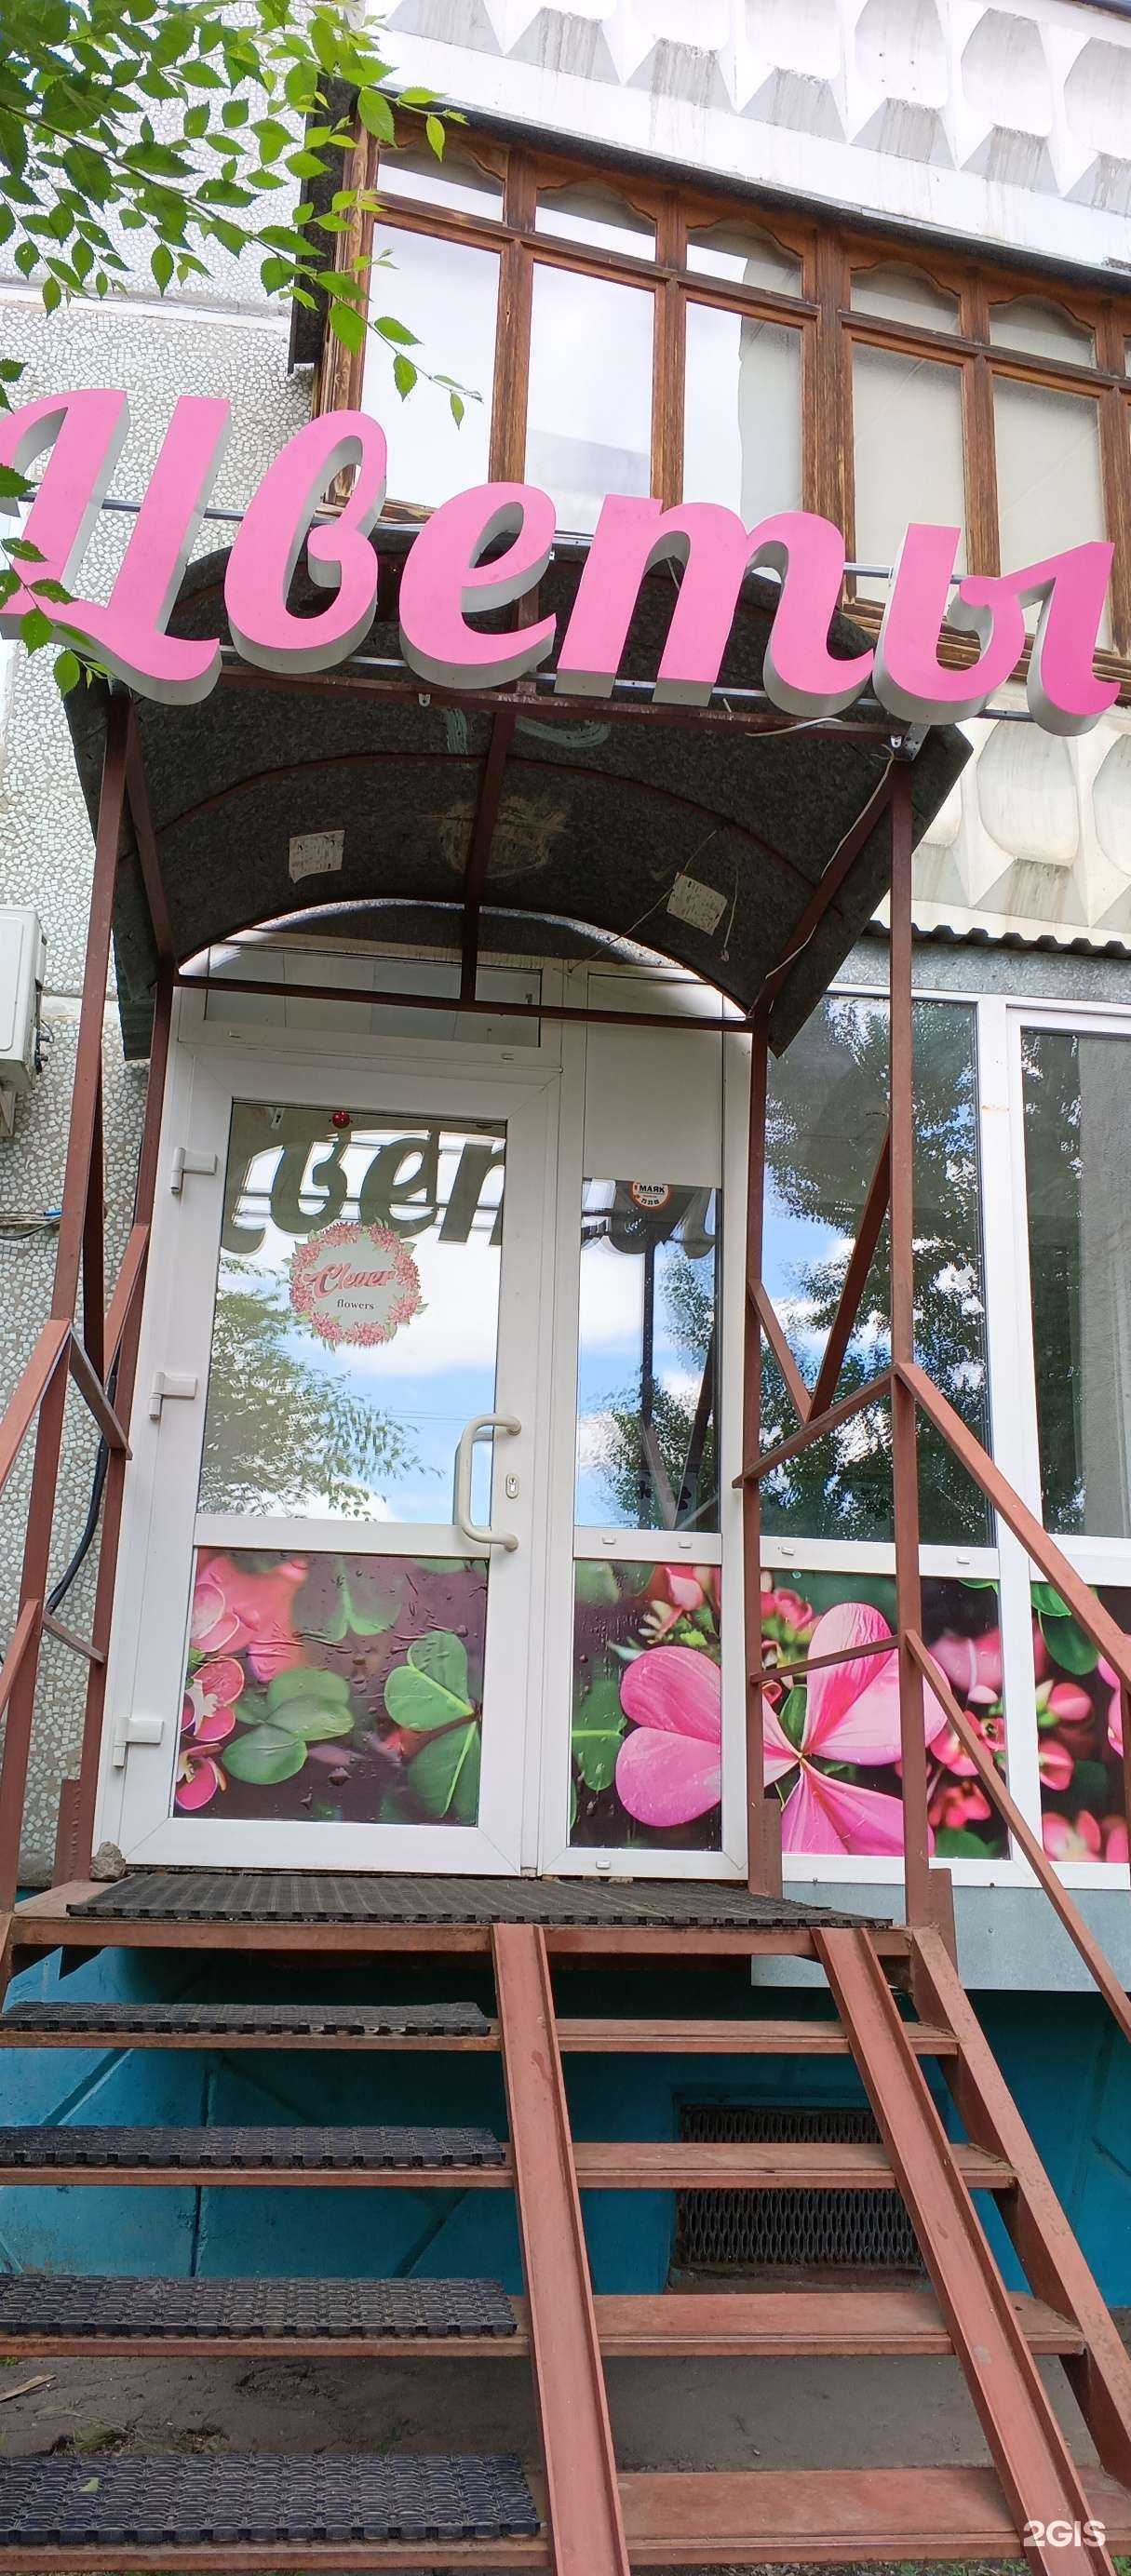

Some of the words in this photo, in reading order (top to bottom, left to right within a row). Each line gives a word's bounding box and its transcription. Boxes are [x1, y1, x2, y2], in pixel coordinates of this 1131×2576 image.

[0, 388, 1122, 737] Цветы
[639, 1185, 666, 1193] МАЯК
[336, 1298, 374, 1310] flowers
